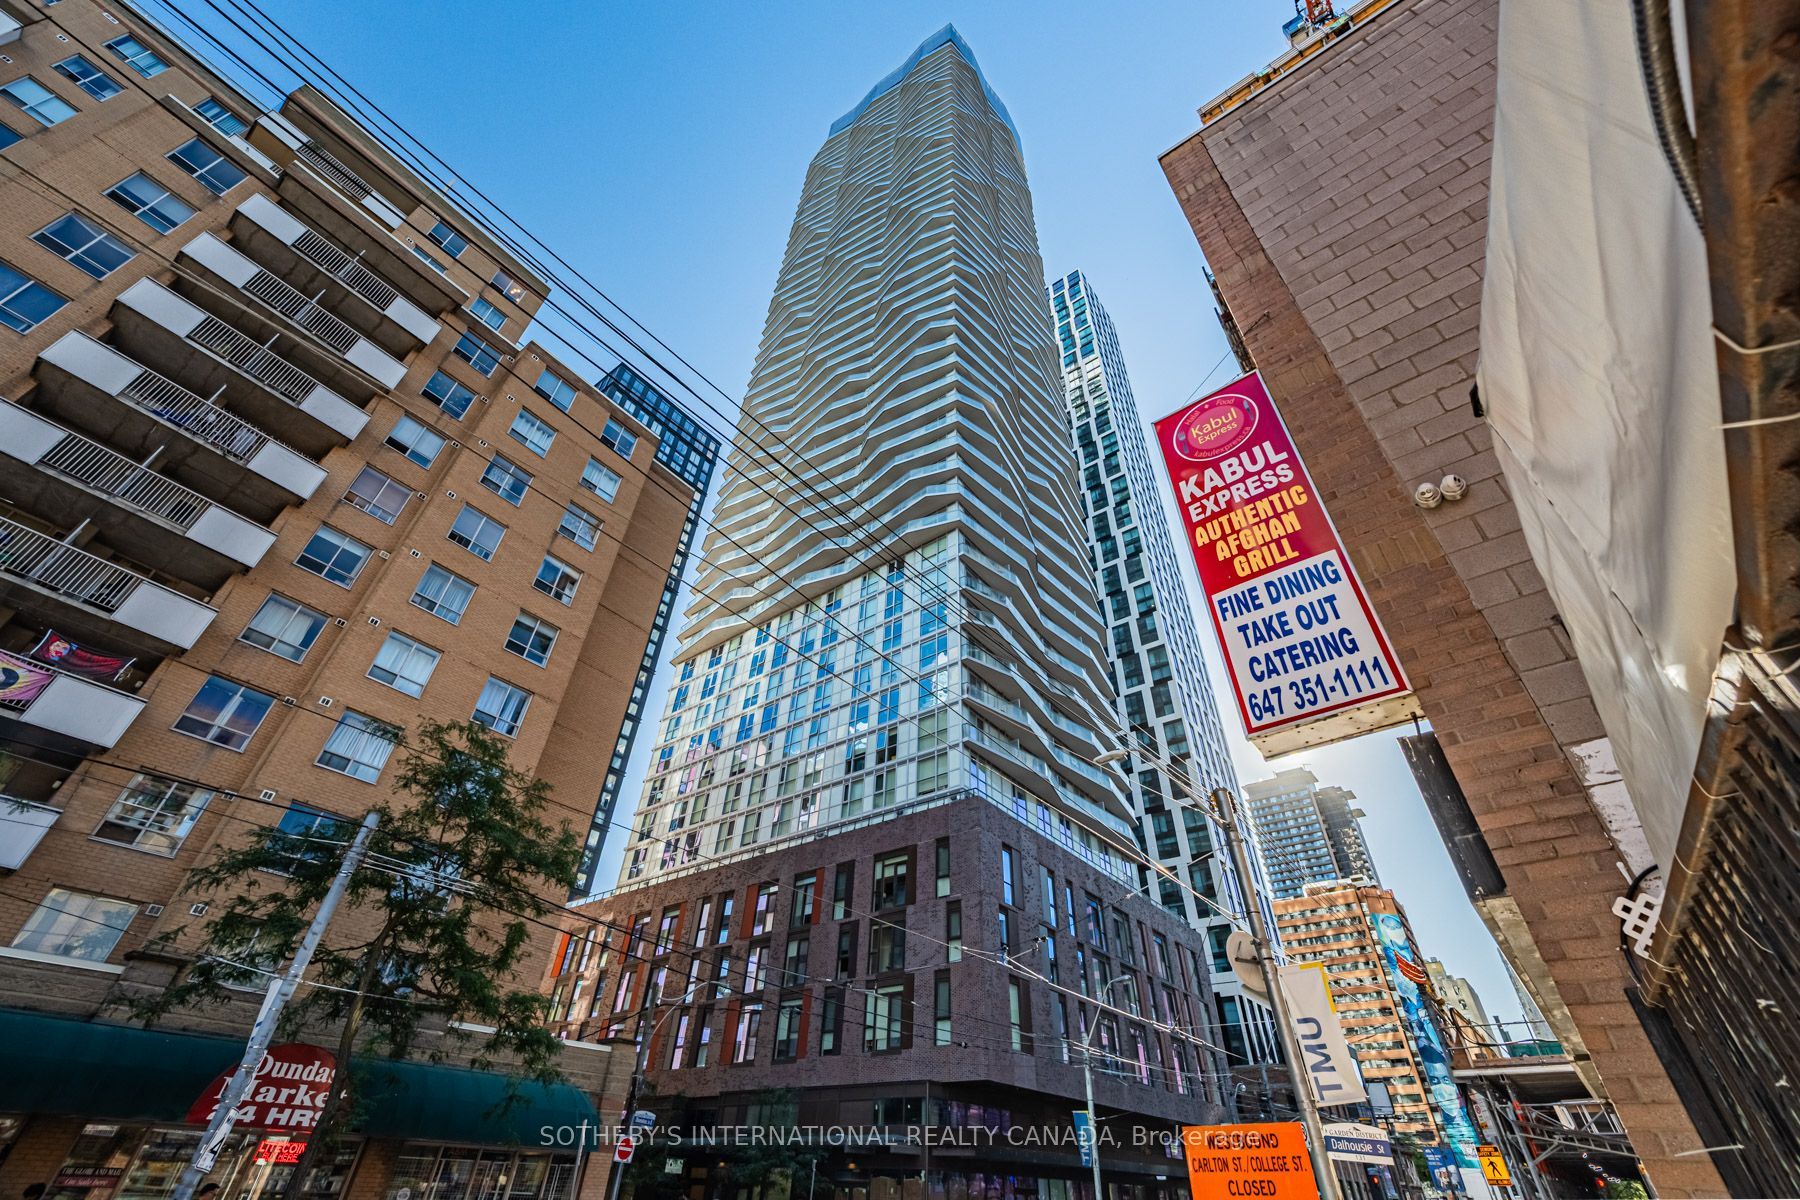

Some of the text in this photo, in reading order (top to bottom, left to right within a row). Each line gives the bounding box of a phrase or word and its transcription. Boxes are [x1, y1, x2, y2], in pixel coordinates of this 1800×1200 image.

[1191, 407, 1238, 438] Kabul
[1215, 397, 1236, 406] Food
[1197, 421, 1238, 445] Express
[1178, 439, 1289, 504] KABUL
[1187, 463, 1294, 523] EXPRESS
[1194, 485, 1309, 547] AUTHENTIC
[1215, 511, 1302, 562] AFGHAN
[1233, 538, 1300, 578] GRILL
[1216, 559, 1342, 622] FINE DINING
[1237, 594, 1342, 650] TAKE OUT
[1248, 627, 1360, 683] CATERING
[1248, 656, 1390, 722] 647 351-1111
[1296, 1016, 1343, 1102] TMU
[1207, 1133, 1279, 1150] WESTBOUND
[1328, 1129, 1383, 1140] GARDEN DISTRICT
[1330, 1138, 1385, 1154] Dalhousie St
[1192, 1157, 1230, 1172] CARLTON
[1292, 1155, 1308, 1172] ST.
[1227, 1179, 1277, 1196] CLOSED
